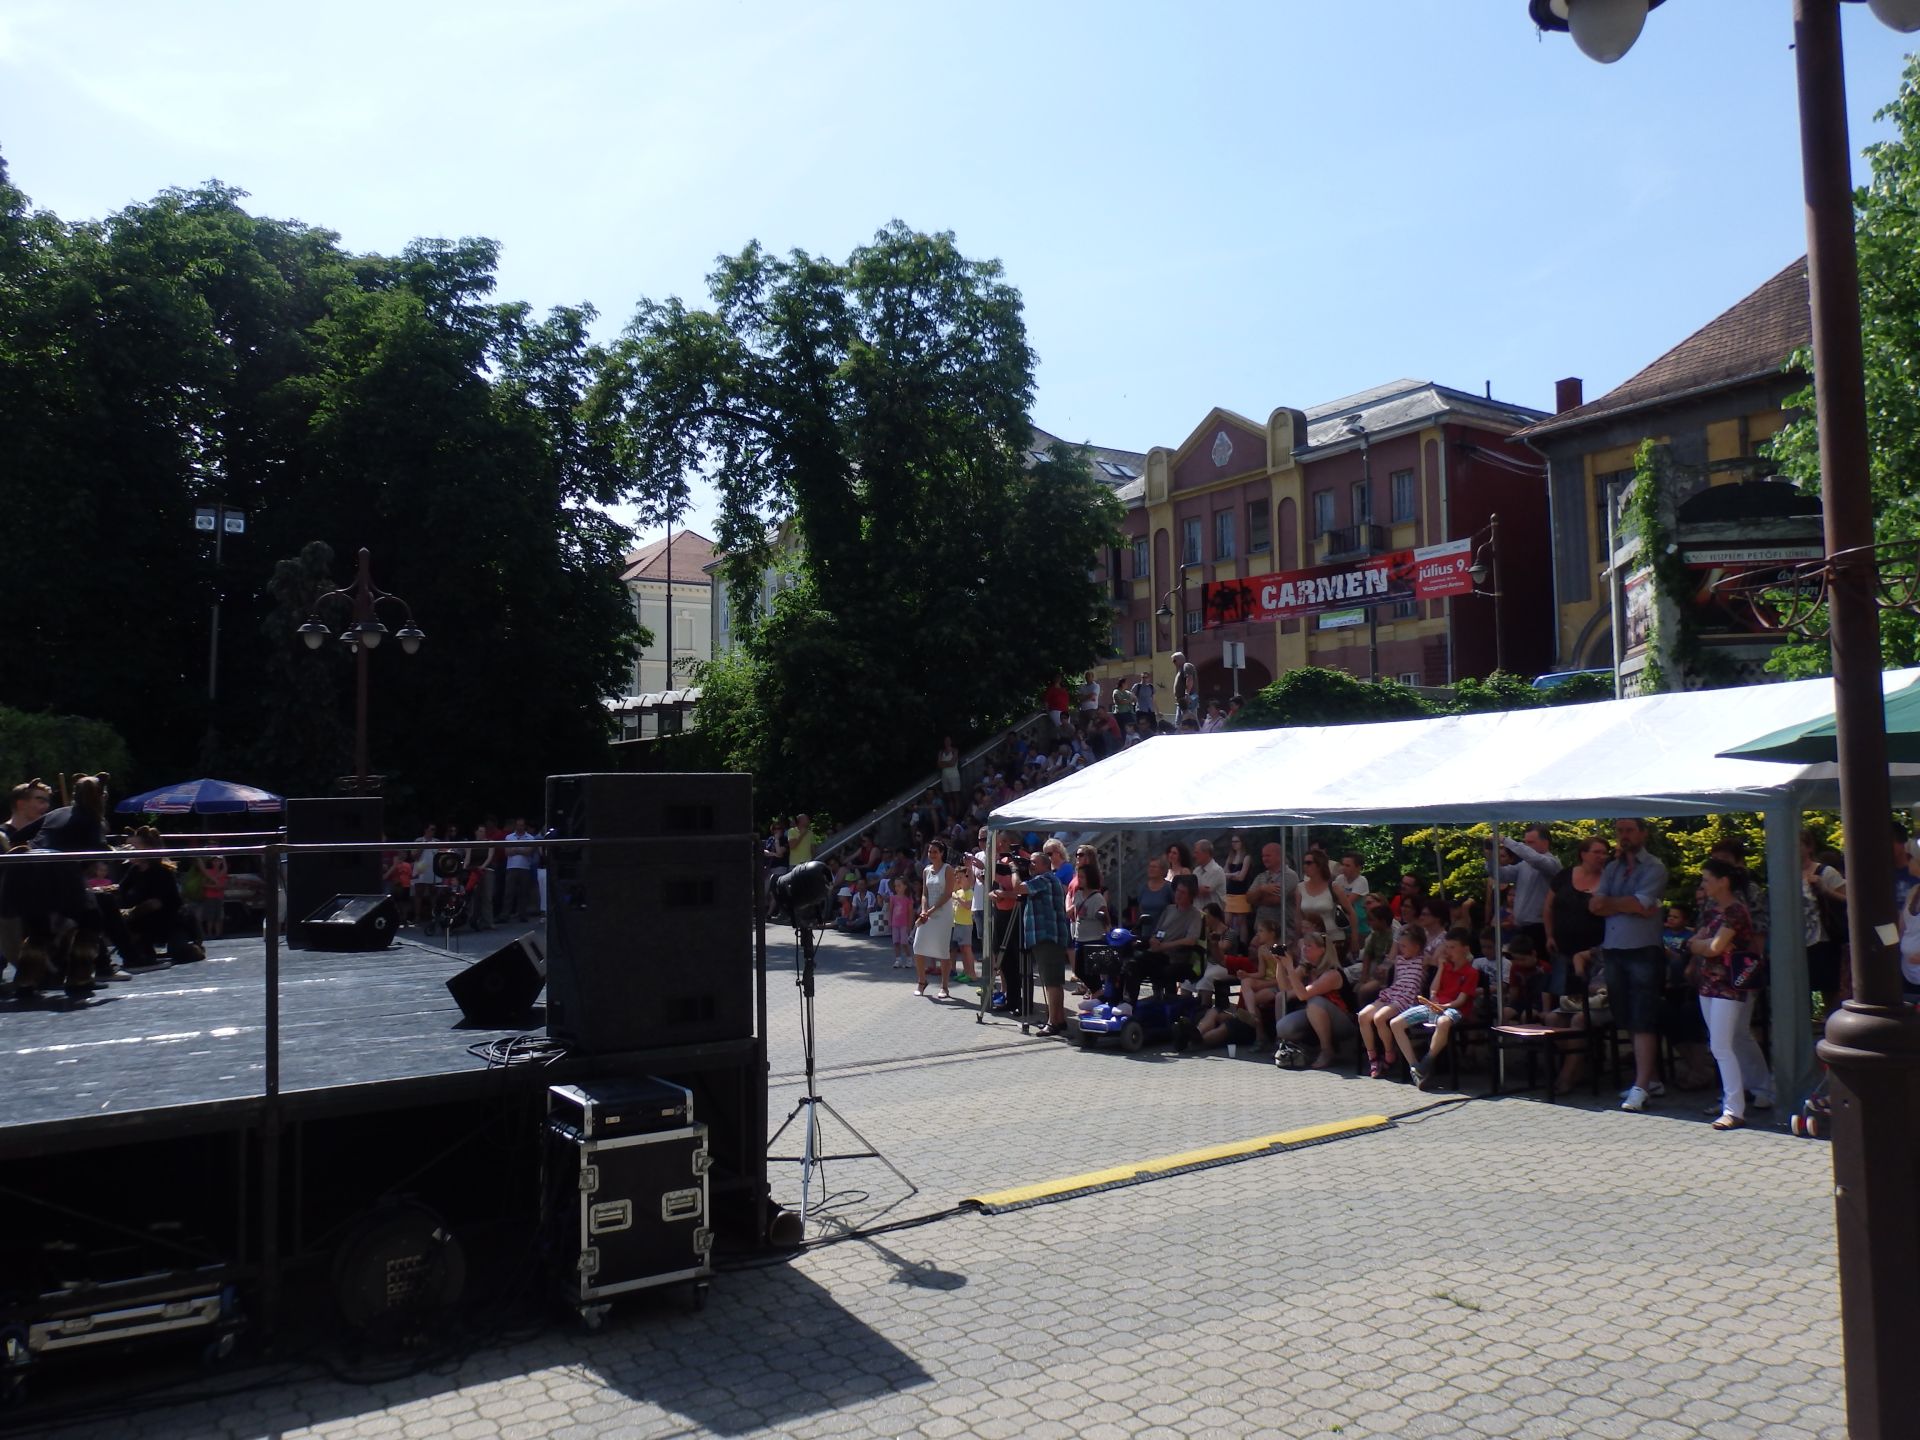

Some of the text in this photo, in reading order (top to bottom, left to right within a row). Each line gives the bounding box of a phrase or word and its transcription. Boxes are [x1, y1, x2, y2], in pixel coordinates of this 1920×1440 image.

[1417, 563, 1454, 582] július
[1456, 558, 1469, 572] 9.
[1261, 568, 1389, 610] CARMEN
